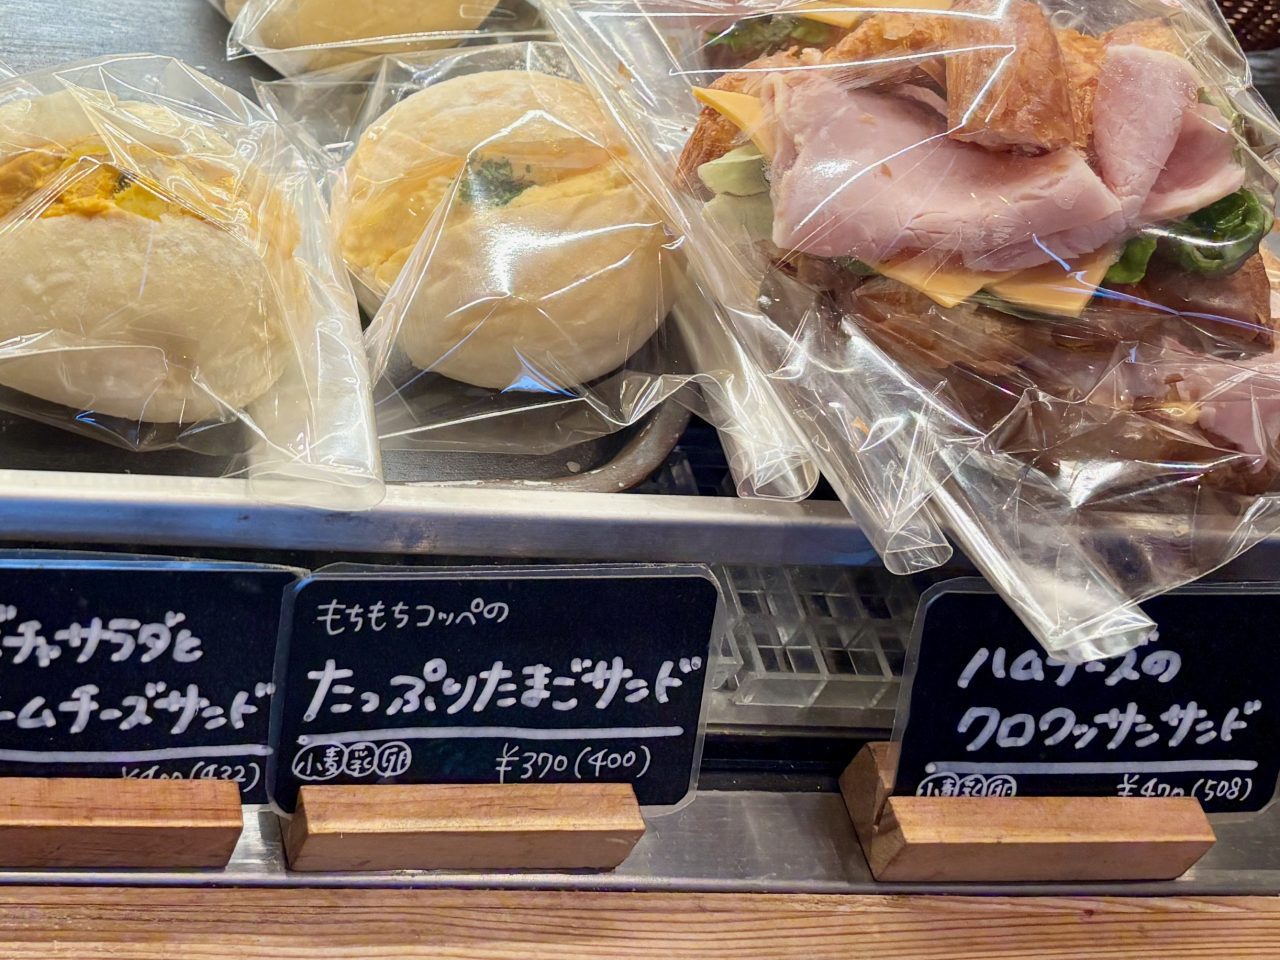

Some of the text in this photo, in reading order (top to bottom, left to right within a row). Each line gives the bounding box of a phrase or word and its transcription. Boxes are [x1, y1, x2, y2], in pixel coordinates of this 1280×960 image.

[316, 597, 510, 636] もちもちコッペの
[303, 656, 703, 722] たっぷりたまごサンド
[495, 743, 652, 784] ¥370(400)
